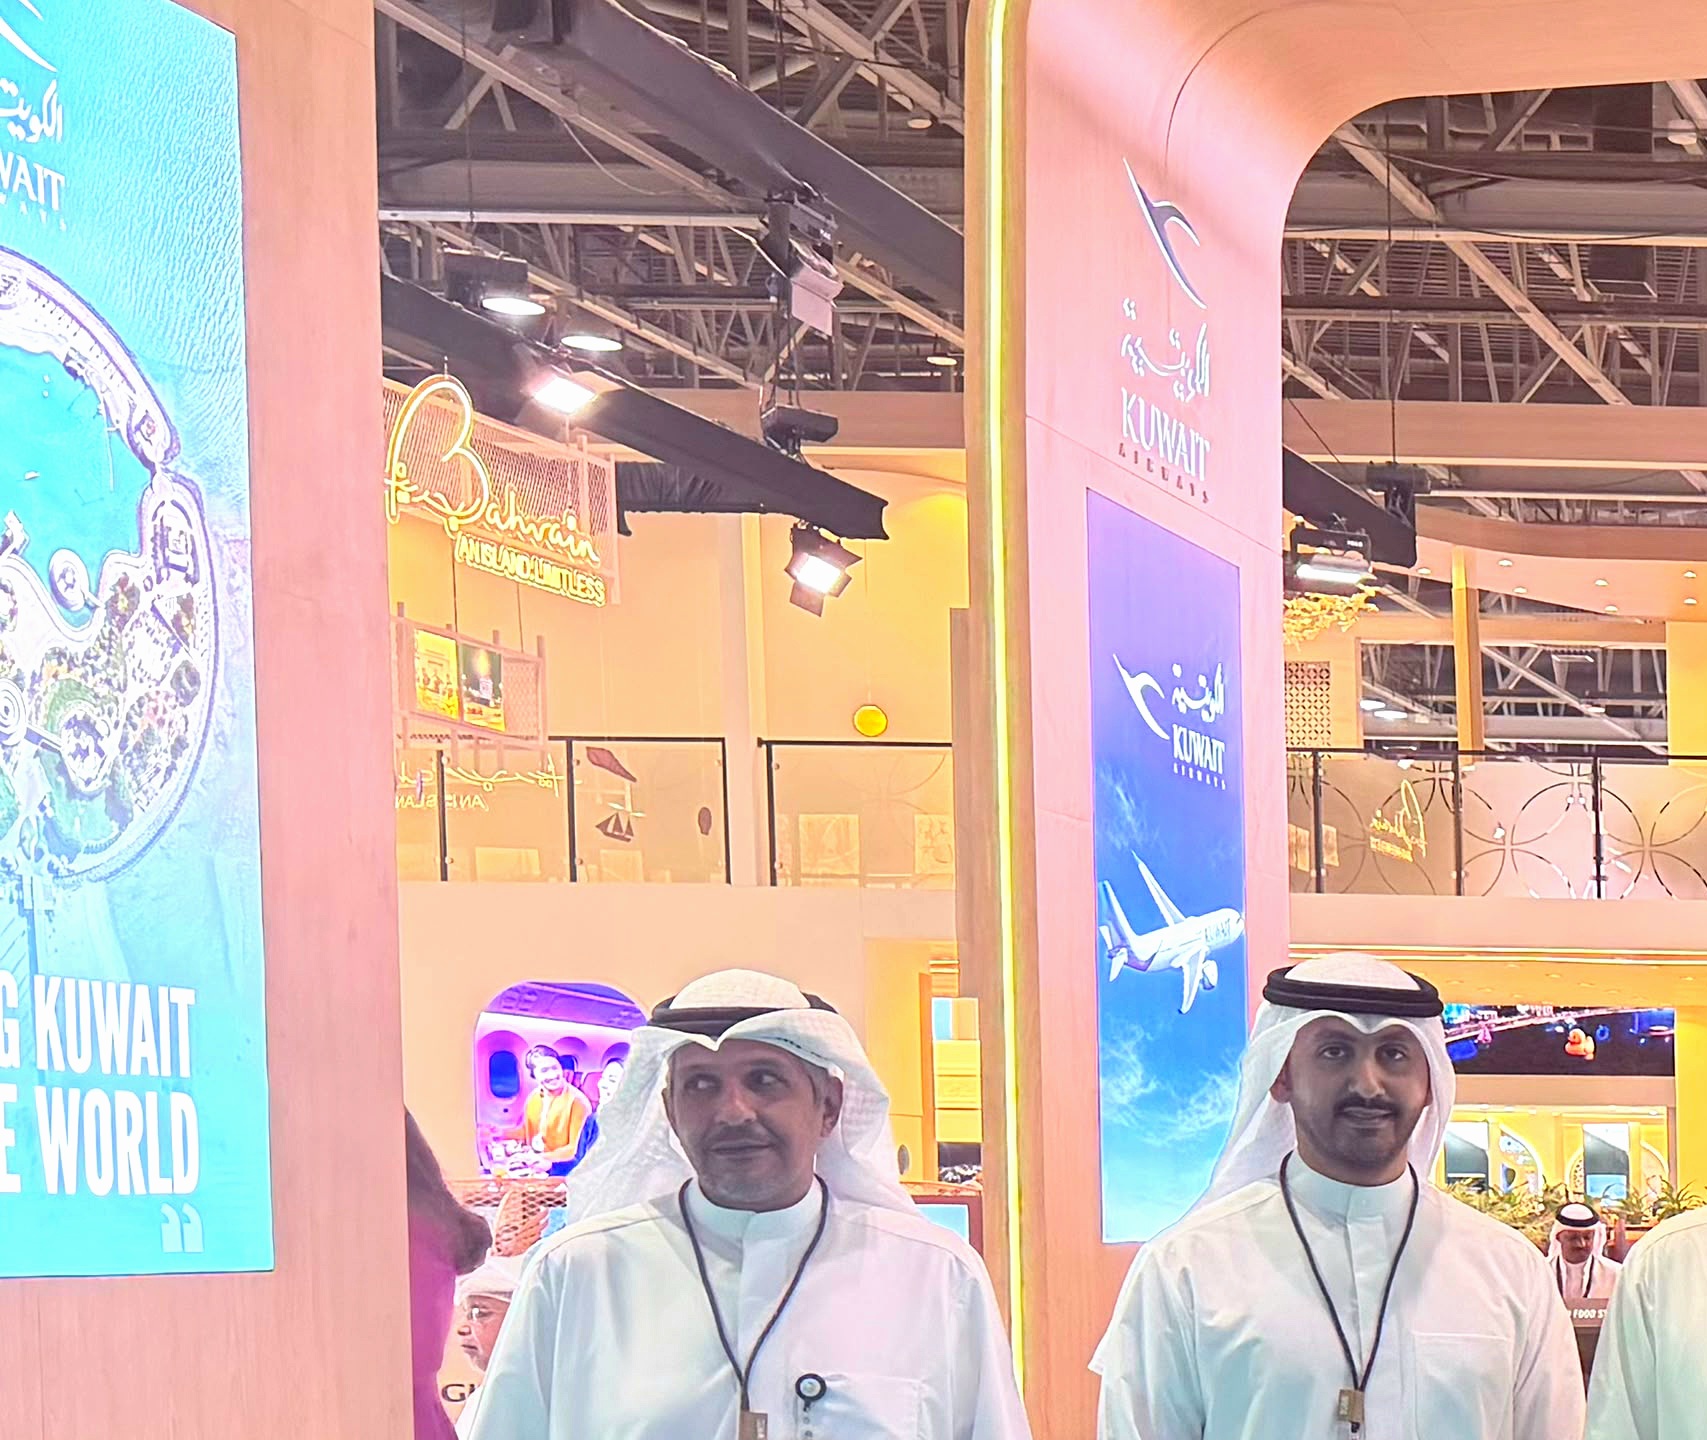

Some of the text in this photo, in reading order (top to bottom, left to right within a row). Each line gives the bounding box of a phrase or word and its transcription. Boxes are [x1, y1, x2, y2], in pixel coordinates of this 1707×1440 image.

[386, 380, 600, 564] Bahrain
[1120, 386, 1211, 482] KUWAIT
[535, 559, 605, 602] LIMITLESS
[1172, 723, 1226, 775] KUWAIT
[34, 974, 196, 1078] KUWAIT
[34, 1085, 200, 1197] WORLD
